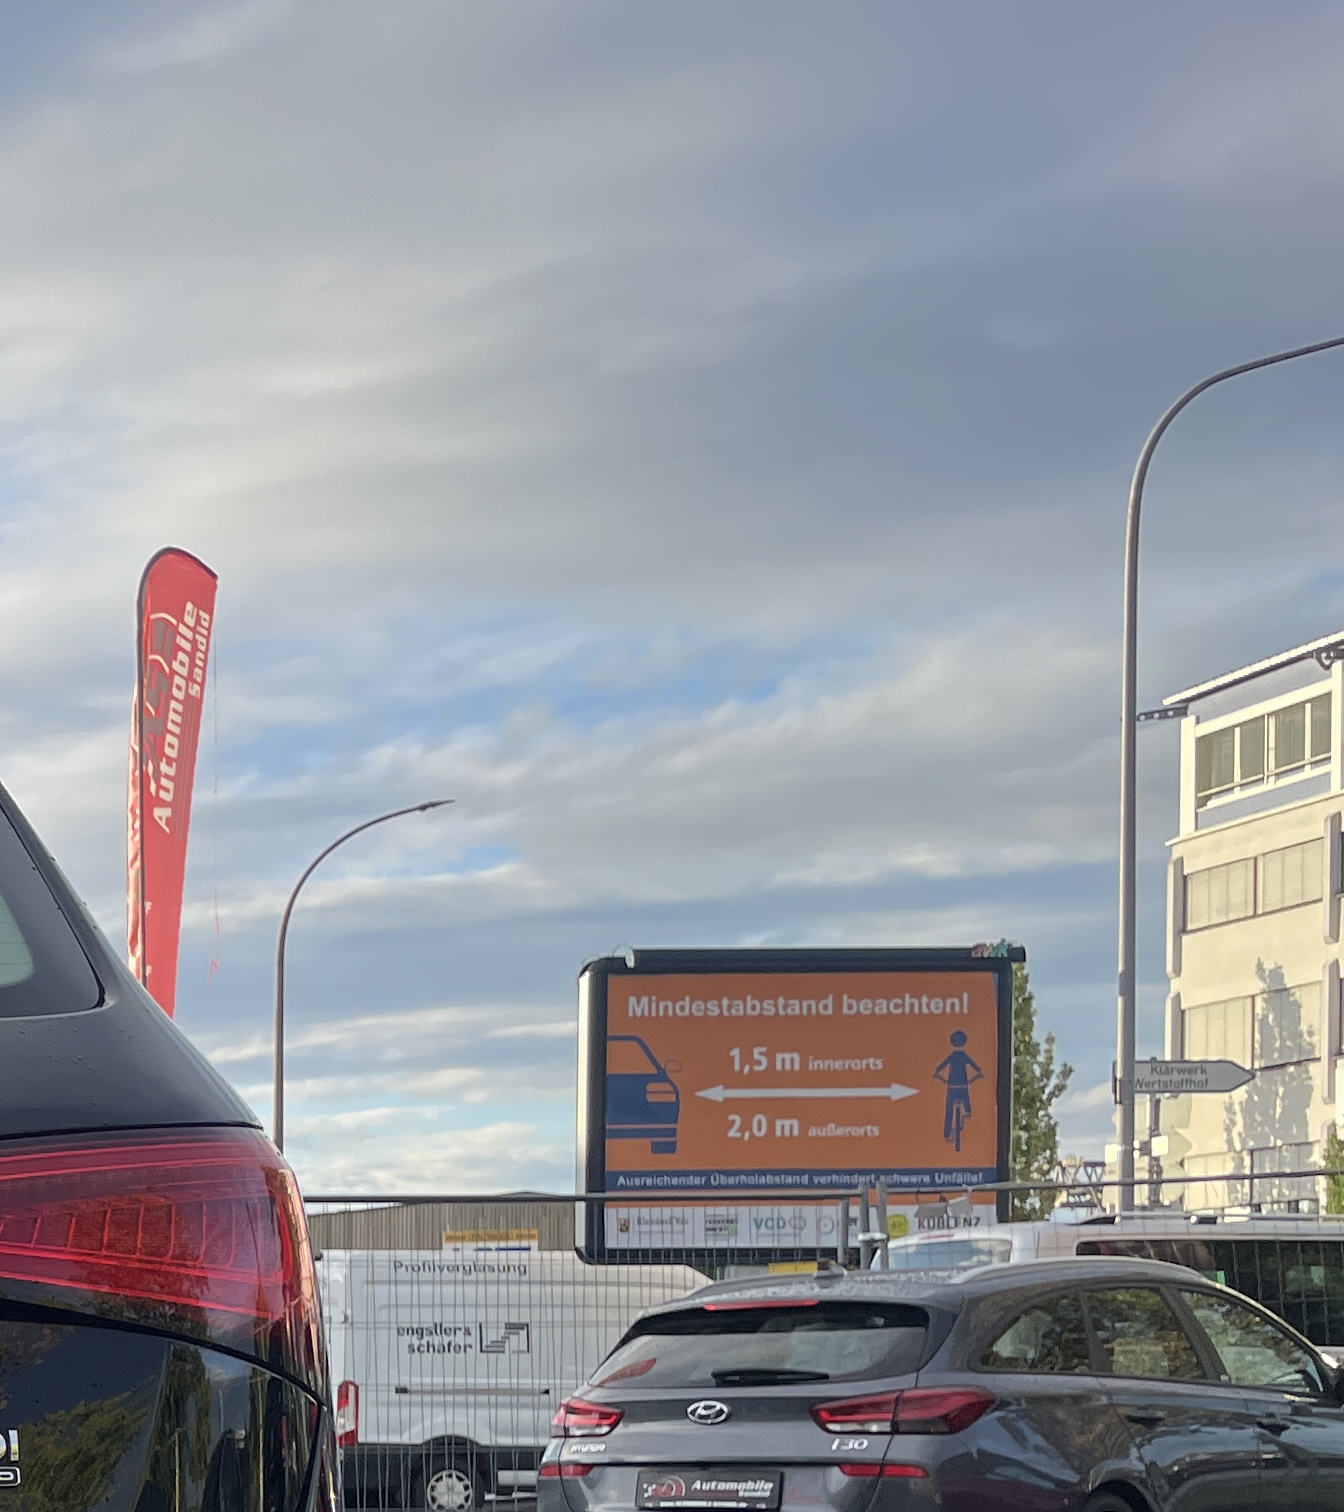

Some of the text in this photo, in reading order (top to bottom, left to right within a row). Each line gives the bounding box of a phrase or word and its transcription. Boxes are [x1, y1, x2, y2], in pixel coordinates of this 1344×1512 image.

[188, 610, 211, 700] Sandid
[153, 601, 197, 834] Automobile
[627, 992, 969, 1018] Mindestabstand beachten!
[729, 1046, 884, 1075] 1,5 m innerorts
[727, 1113, 768, 1141] 2,0
[775, 1118, 799, 1137] m
